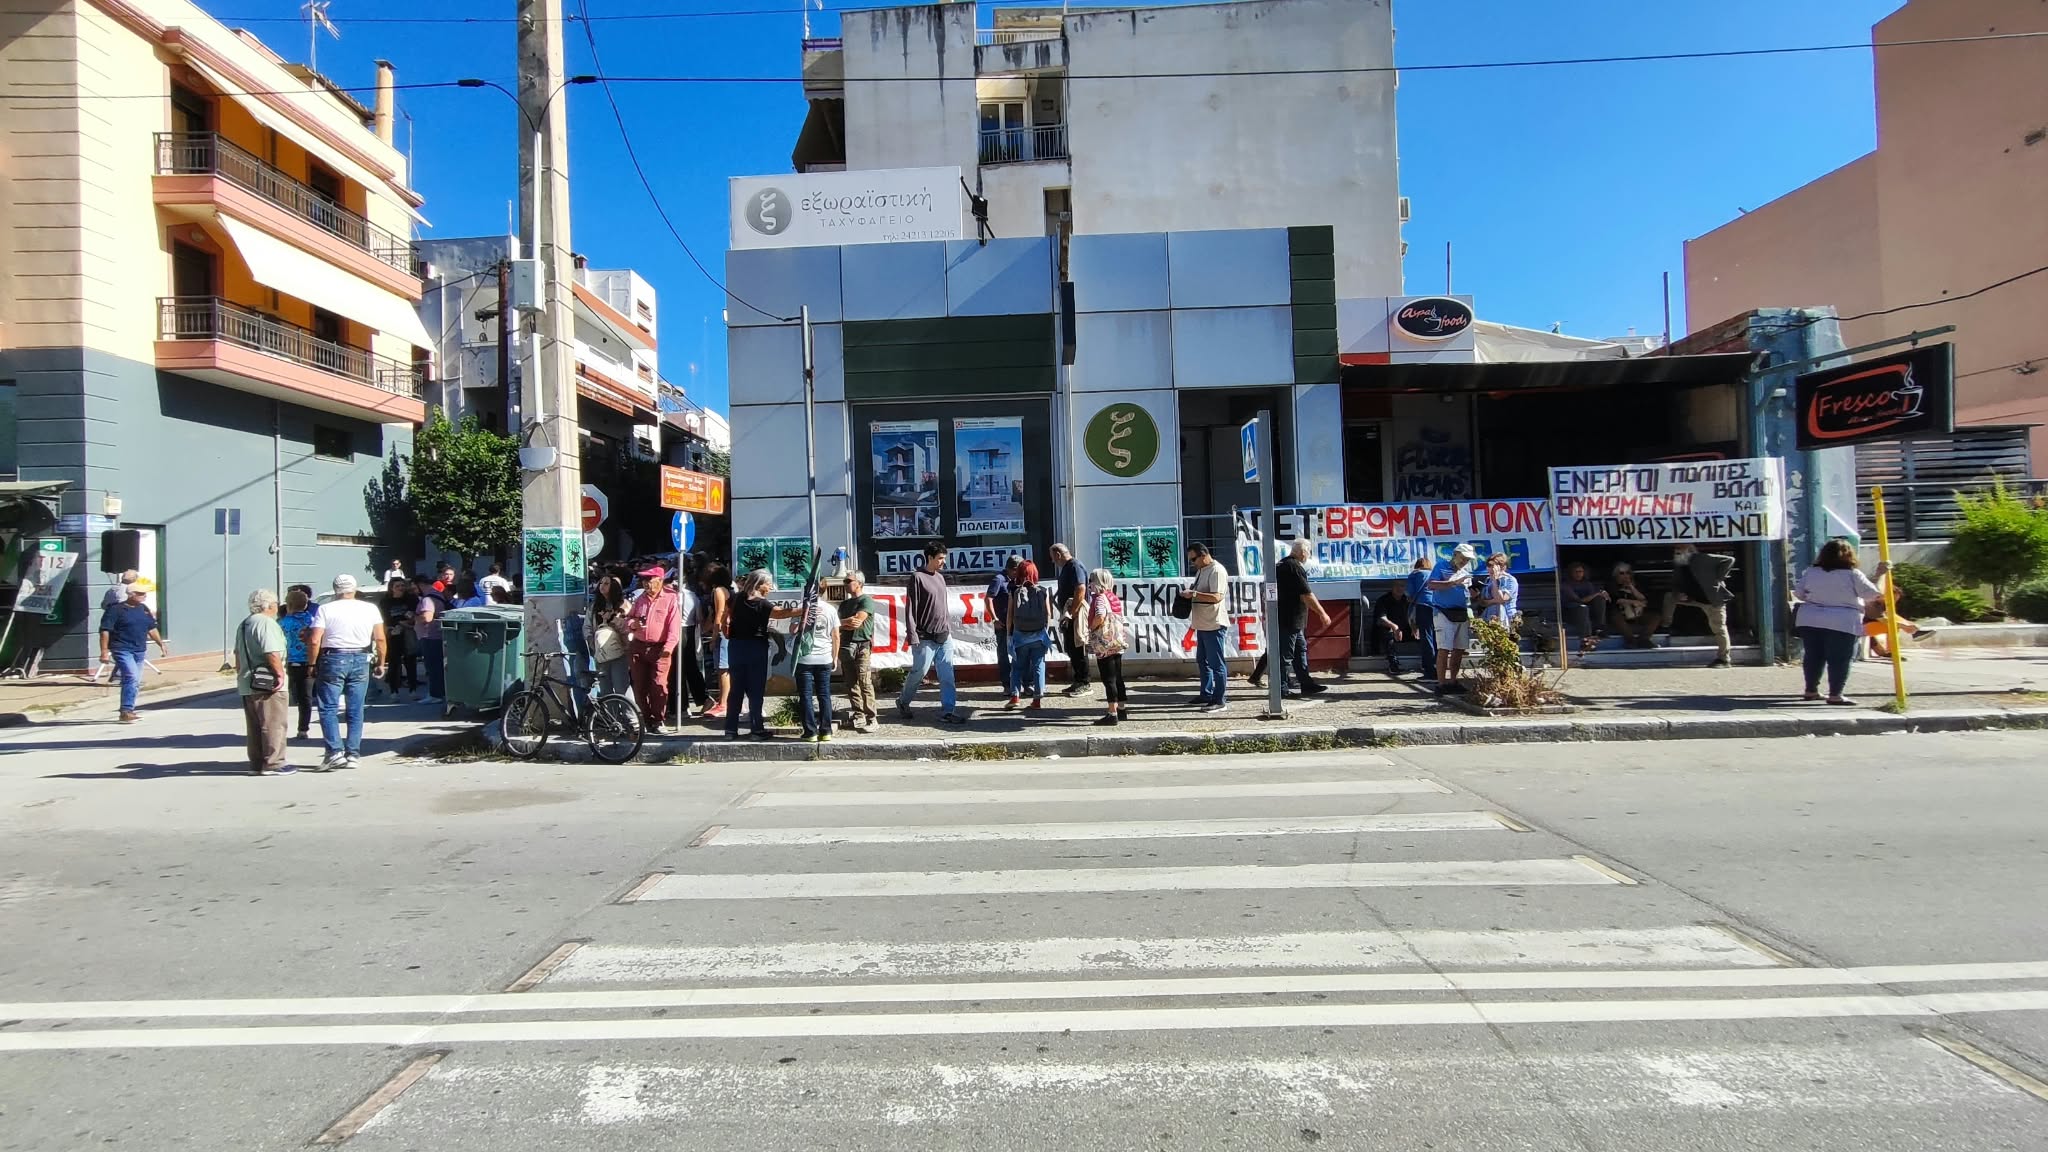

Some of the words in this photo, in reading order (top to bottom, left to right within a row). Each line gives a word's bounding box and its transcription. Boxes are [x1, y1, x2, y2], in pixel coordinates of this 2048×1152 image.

[801, 186, 932, 215] εξωραϊστική
[820, 214, 915, 228] ΤΑΧΥΦΑΓΕΙΟ
[1819, 392, 1891, 417] Fresco
[1554, 468, 1660, 494] ΕΝΕΡΓΟΙ
[1669, 463, 1752, 484] ΠΟΛΙΤΕΣ
[960, 521, 1009, 532] ΠΩΛΕΙΤΑΙ
[1469, 501, 1546, 535] ΠΟΛΥ
[1571, 513, 1769, 540] ΑΠΟΦΑΣΙΣΜΕΝΟΙ
